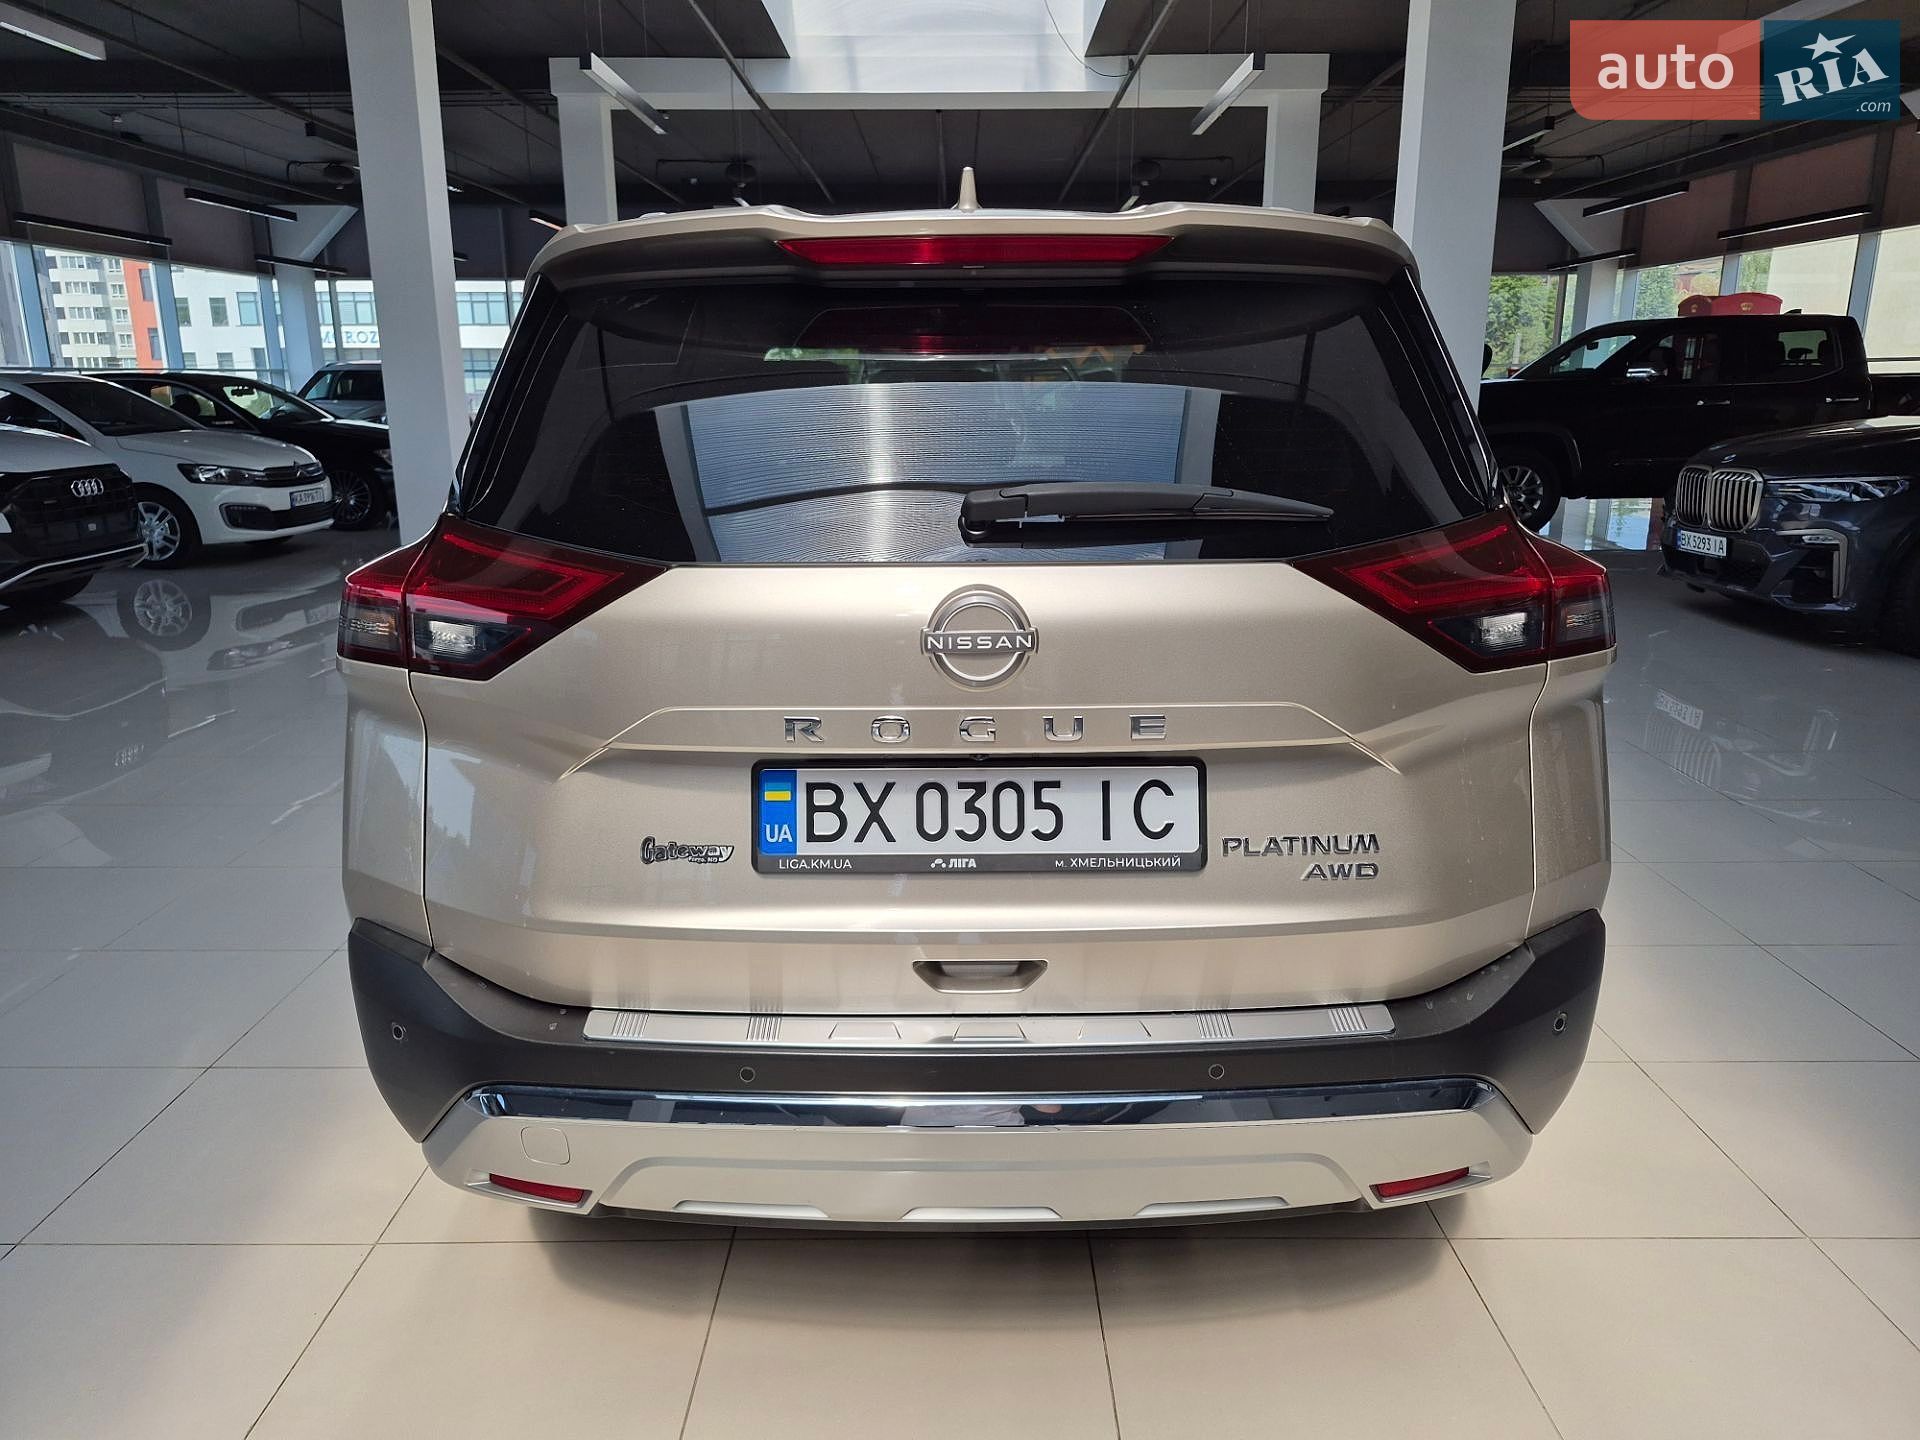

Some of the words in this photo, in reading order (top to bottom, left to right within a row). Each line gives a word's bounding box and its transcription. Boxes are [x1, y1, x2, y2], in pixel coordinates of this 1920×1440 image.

[926, 634, 1033, 650] NISSAN
[783, 714, 1168, 743] ROGUE
[805, 781, 897, 843] BX
[915, 779, 1064, 843] 0305
[1101, 778, 1175, 841] IC
[764, 823, 793, 843] UA
[640, 835, 735, 865] Gateway
[1221, 832, 1381, 858] PLATINUM
[778, 858, 853, 870] LIGA.KM.UA
[948, 857, 977, 869] ЛІГА
[1055, 859, 1068, 868] м.
[1070, 855, 1182, 869] ХМЕЛЬНИЦЬКИЙ
[1300, 862, 1380, 882] AWD
